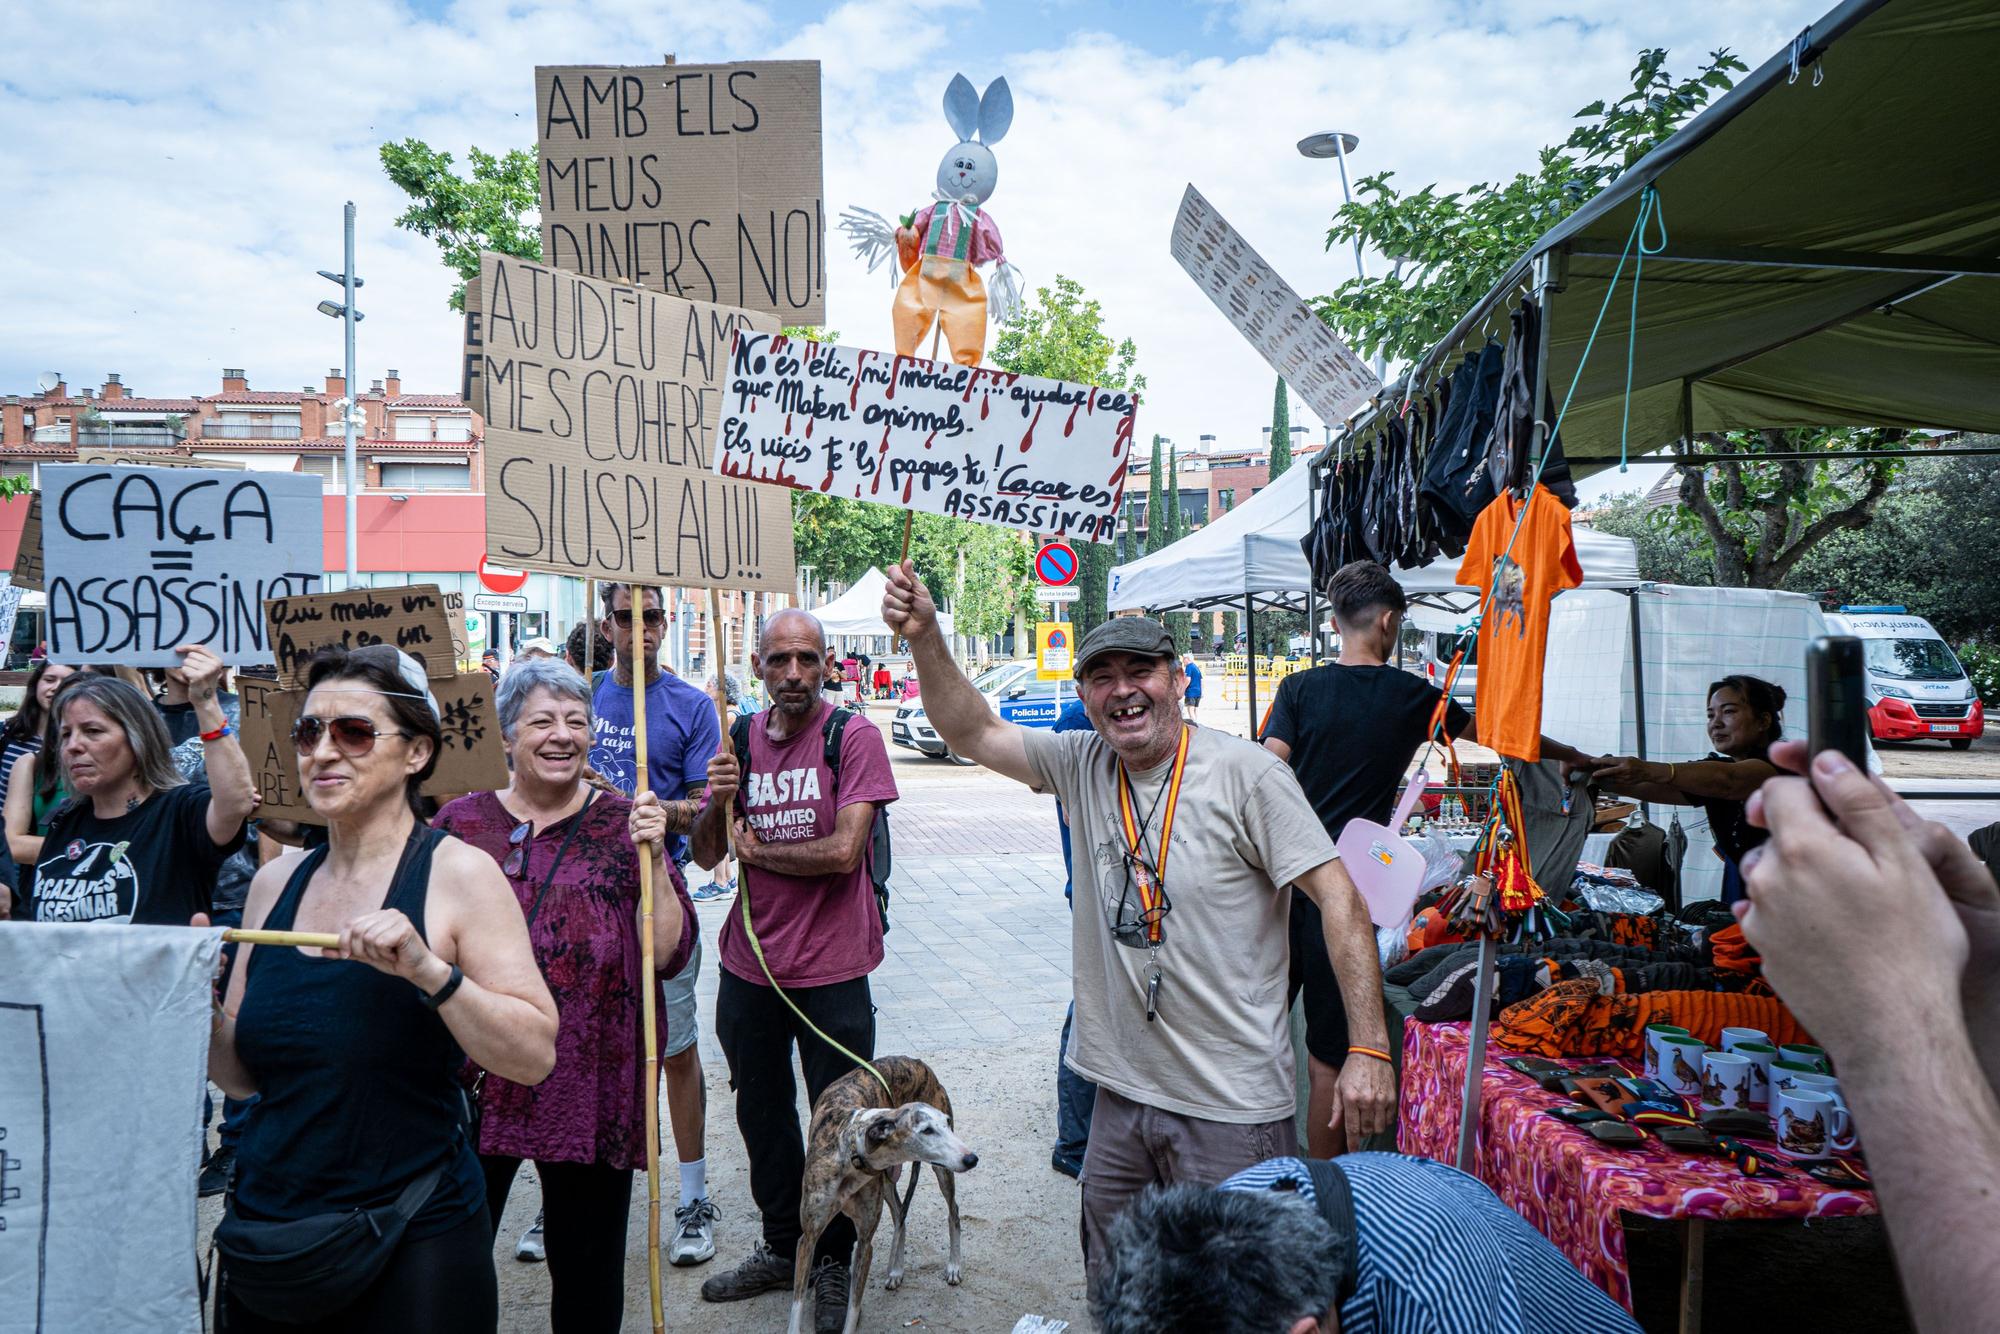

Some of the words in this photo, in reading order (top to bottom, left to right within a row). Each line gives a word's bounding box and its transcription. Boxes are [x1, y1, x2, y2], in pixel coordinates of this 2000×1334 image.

[545, 74, 648, 139] AMB
[676, 70, 759, 136] ELS
[546, 154, 662, 212] MEUS
[551, 219, 718, 304] DINERS
[737, 199, 821, 308] NO!
[490, 260, 656, 371] AJUDEU
[734, 334, 768, 376] No
[861, 363, 891, 384] ni
[486, 355, 572, 437] MES
[583, 370, 718, 469] COHERÈ
[733, 379, 774, 413] que
[775, 378, 850, 421] Maten
[723, 417, 751, 453] Els
[59, 473, 273, 544] CAÇA
[270, 599, 322, 637] Qui
[402, 595, 436, 613] un
[477, 598, 501, 607] Excepte
[502, 600, 524, 608] serveis
[397, 624, 432, 648] un
[1011, 708, 1039, 717] Policia
[1040, 707, 1056, 716] Loc
[602, 737, 634, 754] caza
[747, 767, 822, 808] BASTA
